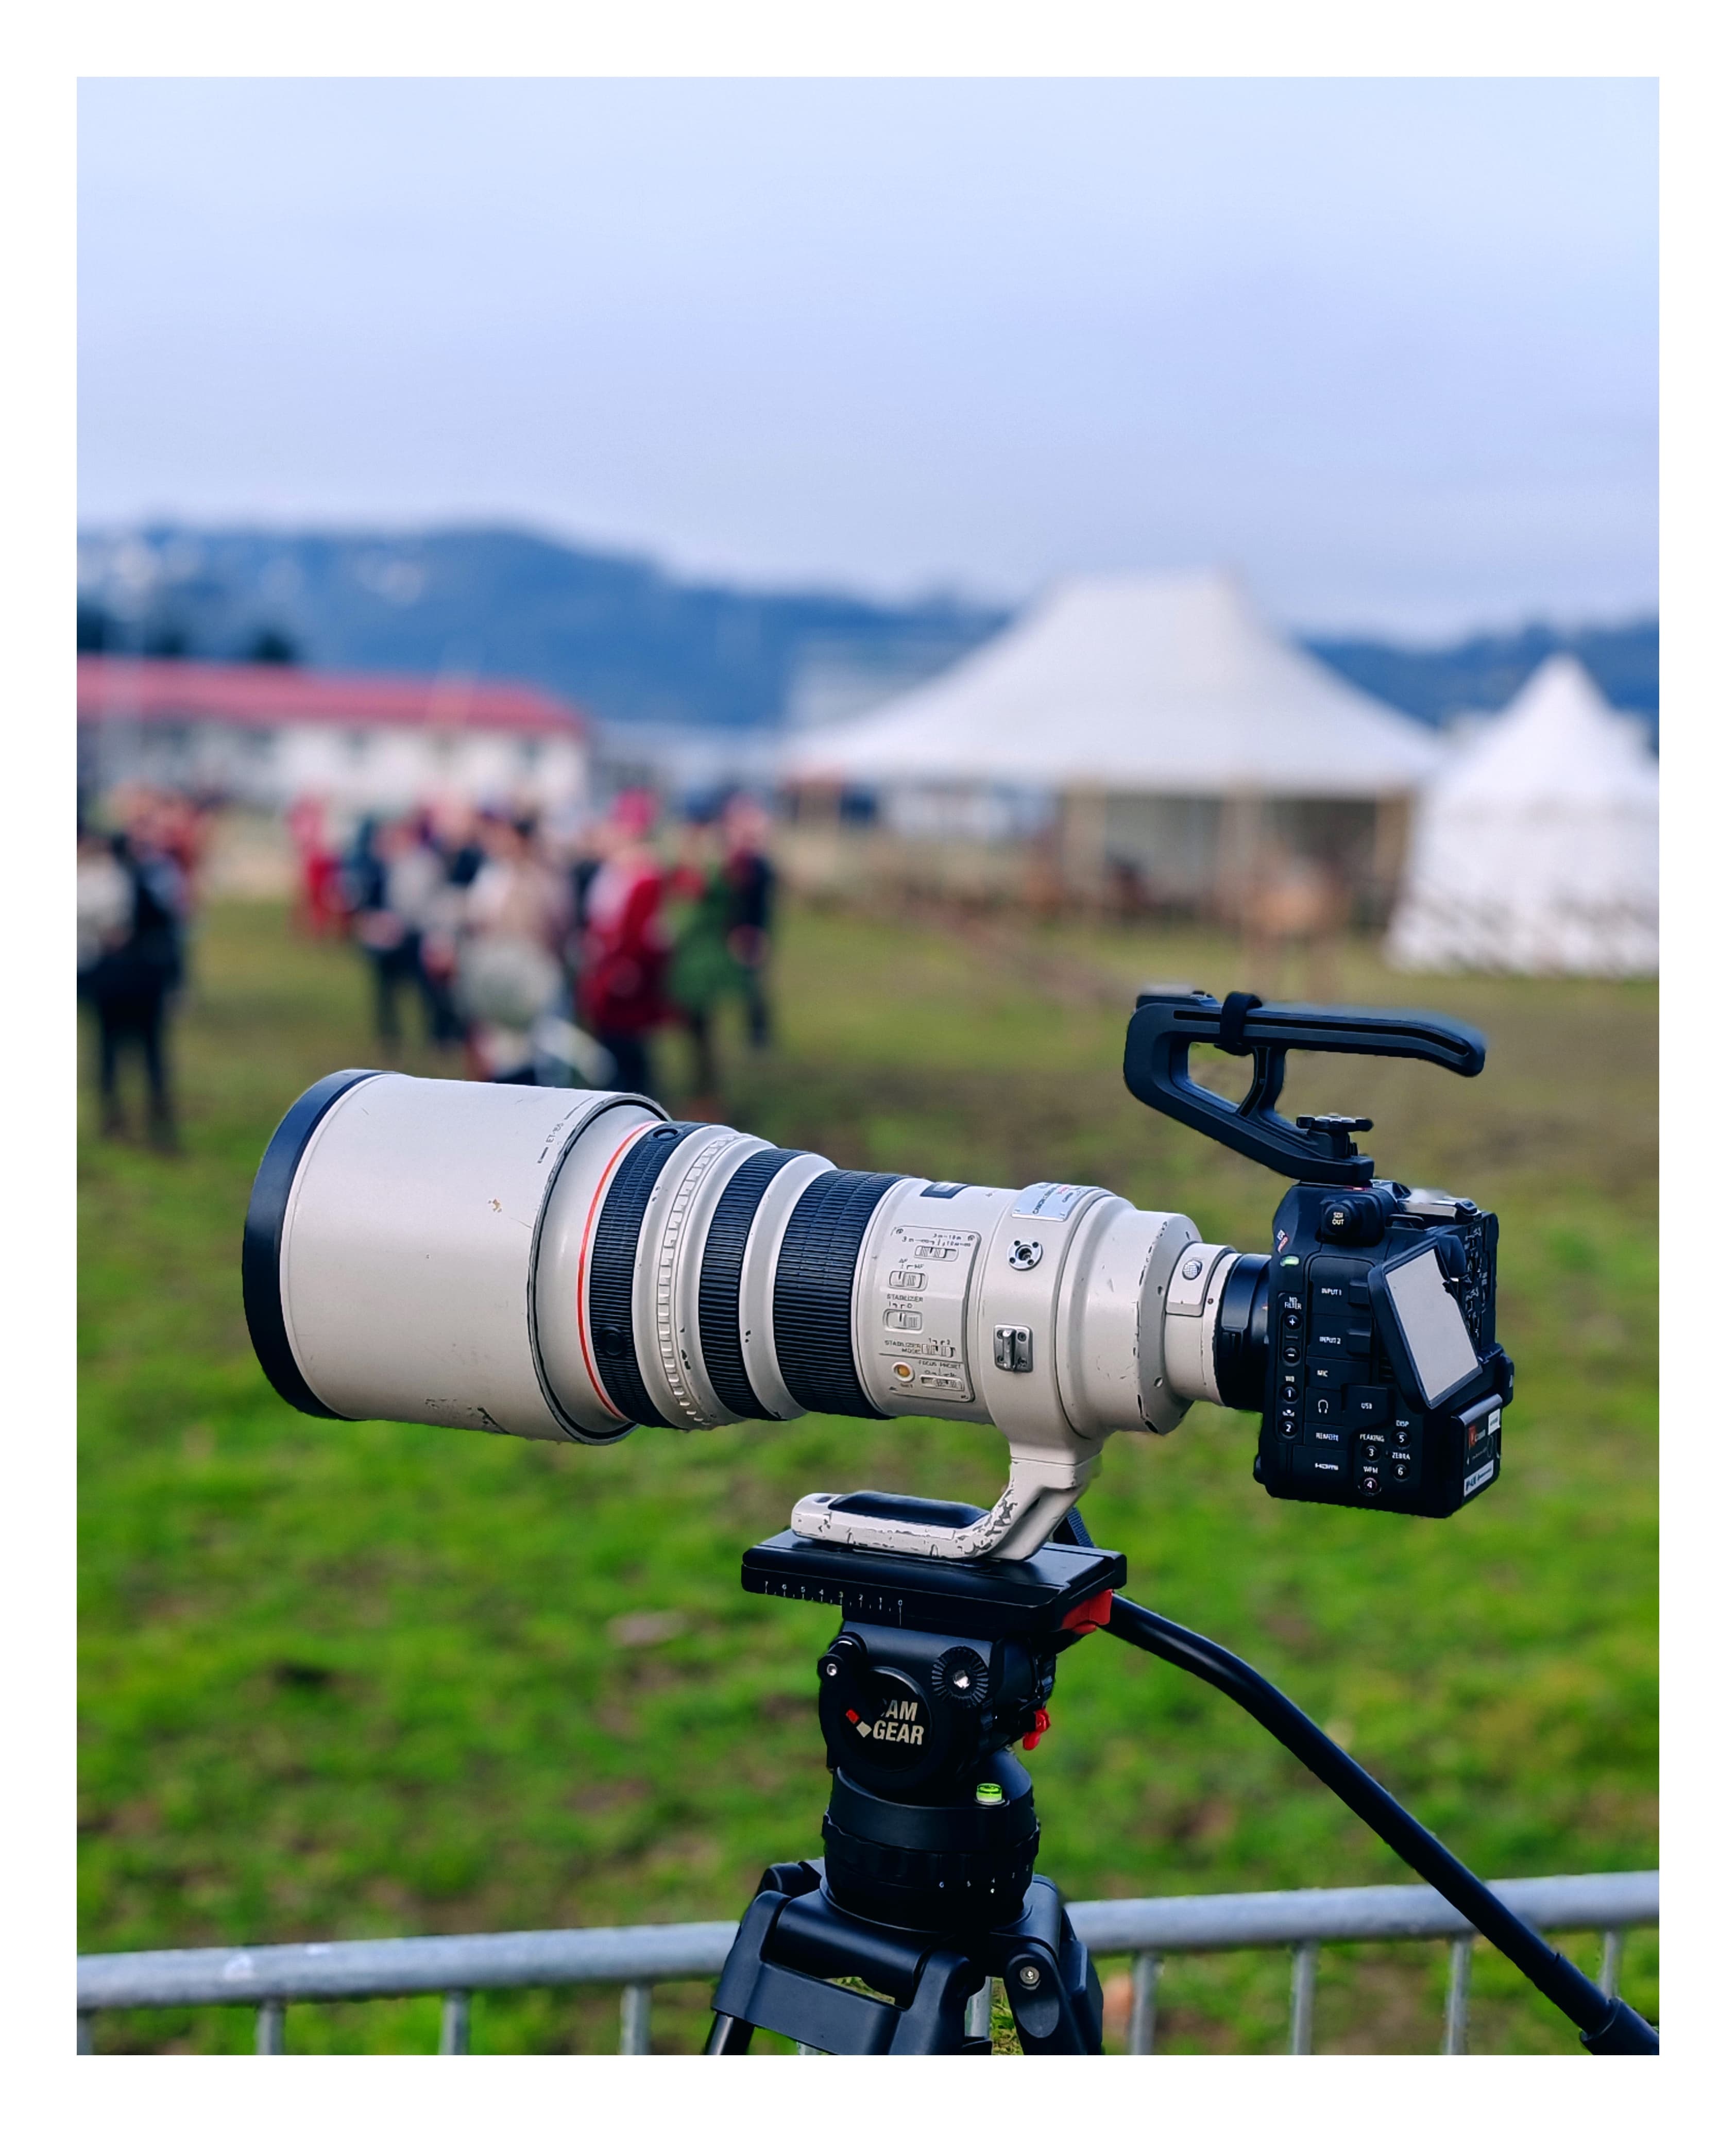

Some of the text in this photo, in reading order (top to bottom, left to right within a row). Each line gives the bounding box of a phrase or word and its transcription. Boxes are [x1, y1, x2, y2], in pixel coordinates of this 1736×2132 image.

[1286, 1424, 1291, 1432] 2
[1359, 1433, 1385, 1443] PEAKING
[1369, 1448, 1374, 1457] 3
[1392, 1452, 1410, 1460] ZEBRA
[1398, 1467, 1403, 1476] 6
[880, 1698, 918, 1721] AM
[873, 1719, 925, 1746] GEAR
